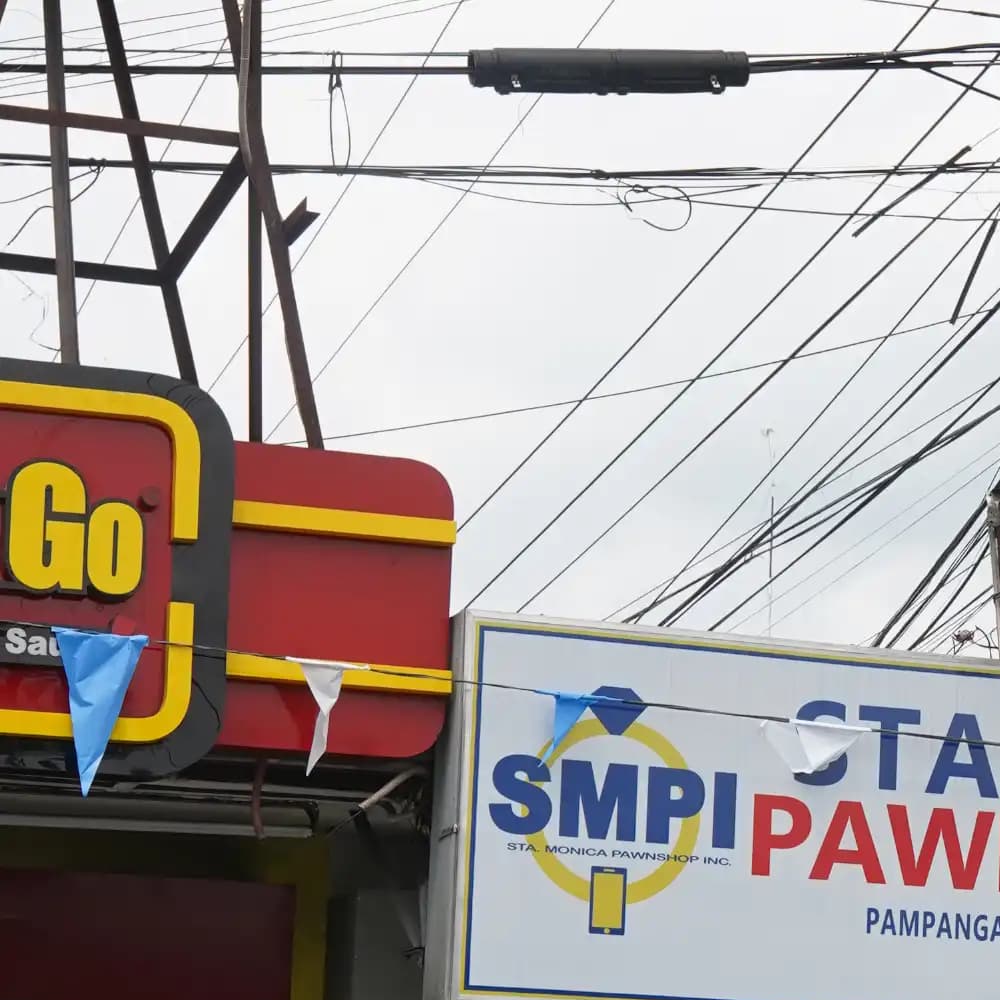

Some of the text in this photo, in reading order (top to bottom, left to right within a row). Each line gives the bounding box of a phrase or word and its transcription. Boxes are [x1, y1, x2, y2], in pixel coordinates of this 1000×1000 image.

[8, 461, 144, 596] Go
[488, 753, 738, 849] SMPI
[506, 842, 732, 867] STA. MONICA PAWNSHOP INC.
